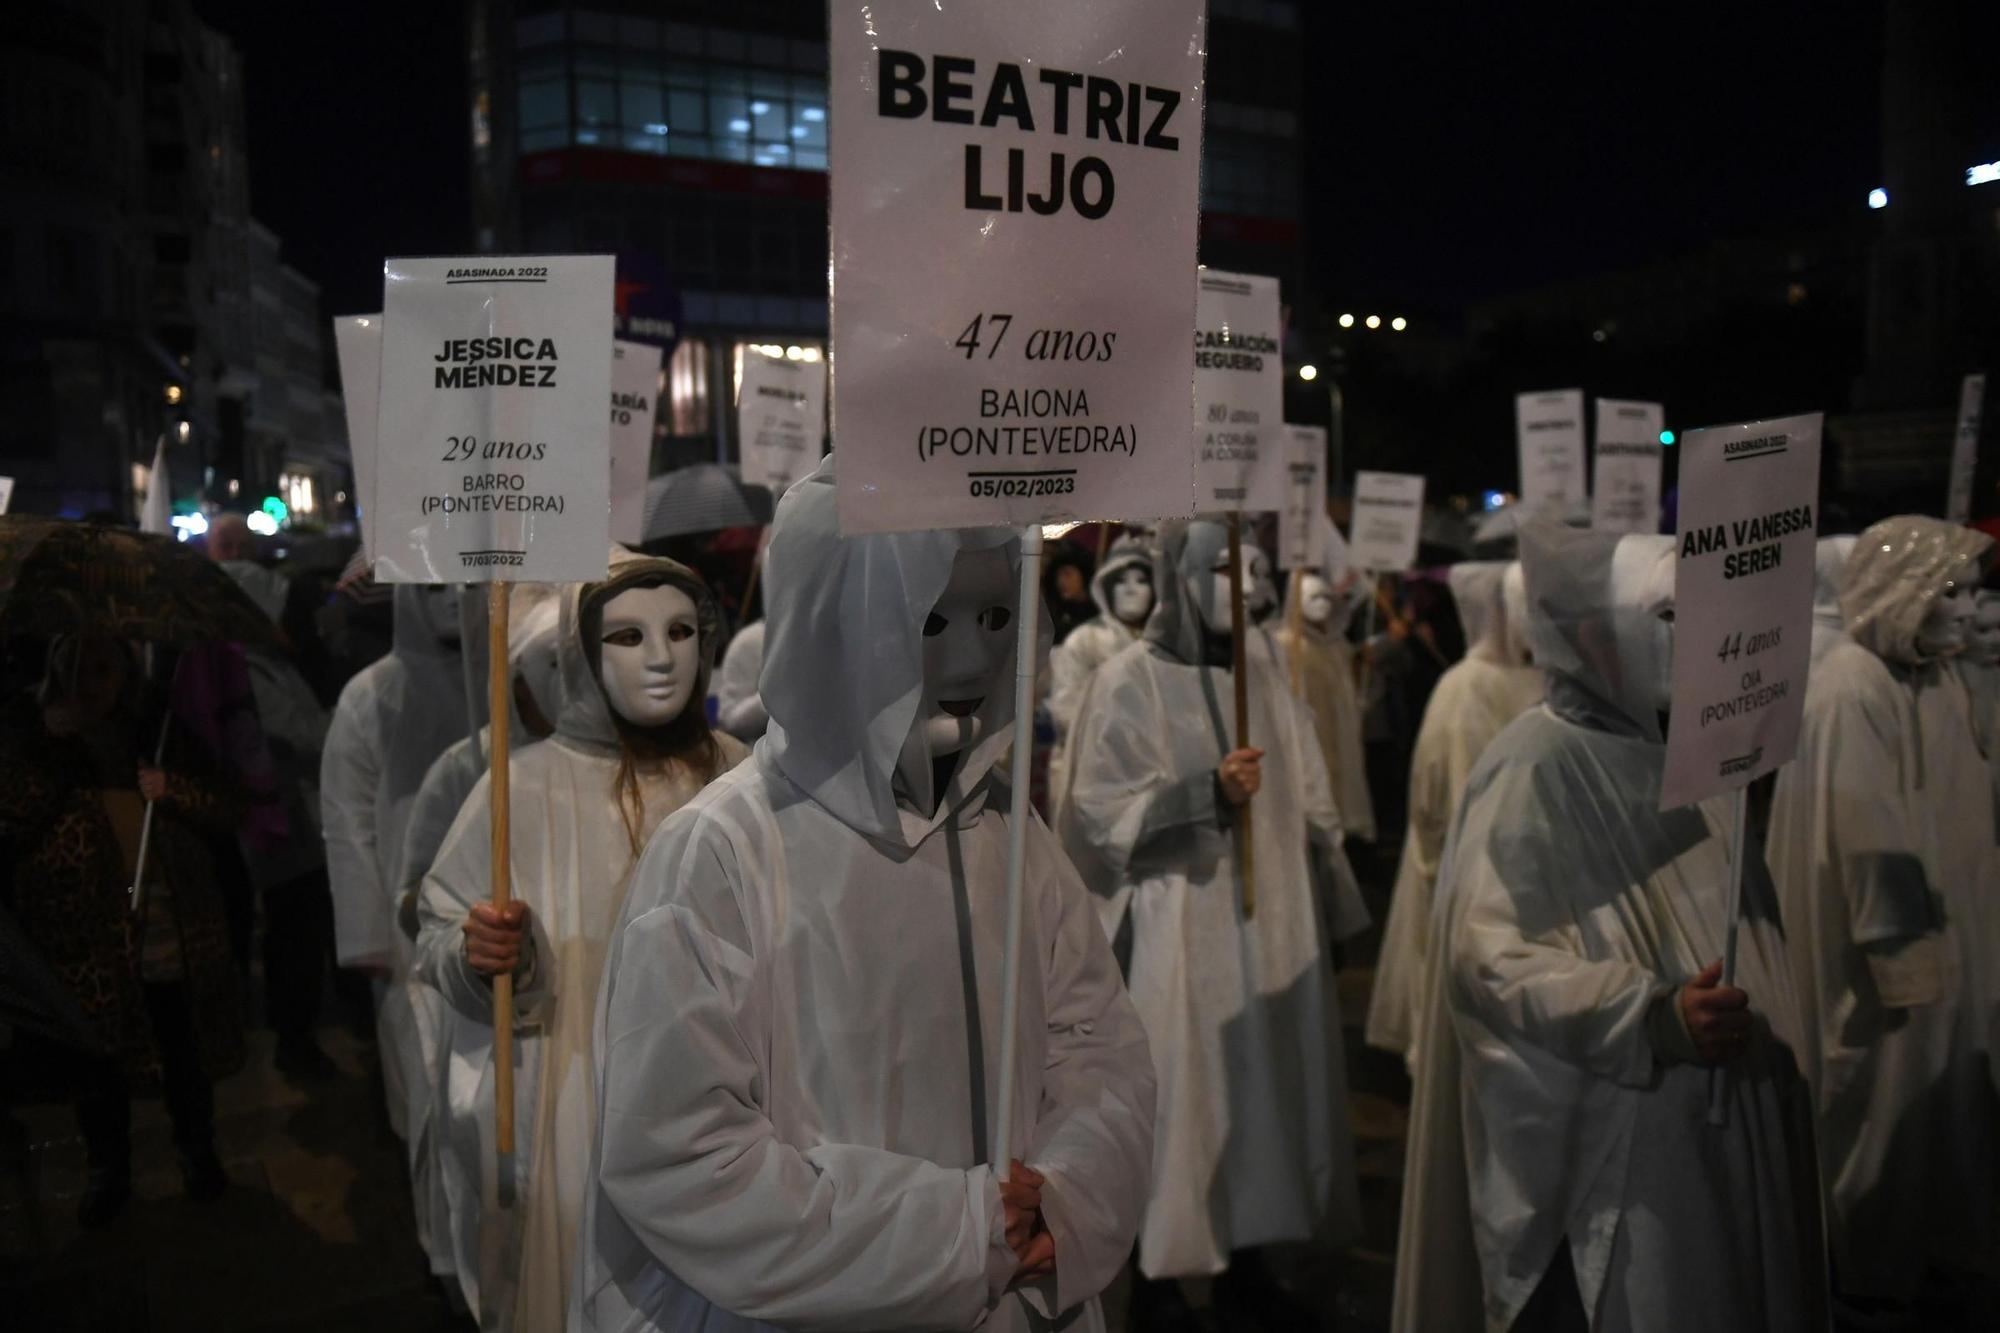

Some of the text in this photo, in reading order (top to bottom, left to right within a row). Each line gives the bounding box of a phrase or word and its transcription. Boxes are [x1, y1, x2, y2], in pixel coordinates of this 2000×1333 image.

[878, 48, 1181, 151] BEATRIZ
[965, 144, 1115, 220] LIJO
[446, 267, 547, 279] ASASINADA 2022
[435, 337, 558, 362] JESSICA
[955, 313, 1117, 361] 47 anos
[435, 359, 556, 388] MÉNDEZ
[980, 389, 1090, 418] BAIONA
[443, 436, 546, 462] 29 anos
[918, 424, 1136, 462] (PONTEVEDRA)
[1723, 438, 1768, 454] ASASINADA
[463, 474, 524, 492] BARRO
[970, 478, 1075, 498] 05/02/2023
[421, 495, 564, 515] (PONTEVEDRA)
[1681, 505, 1812, 559] ANA VANESSA
[1724, 542, 1781, 580] SEREN
[1717, 626, 1782, 663] 44 anos
[1701, 680, 1789, 728] (PONTEVEDRA)
